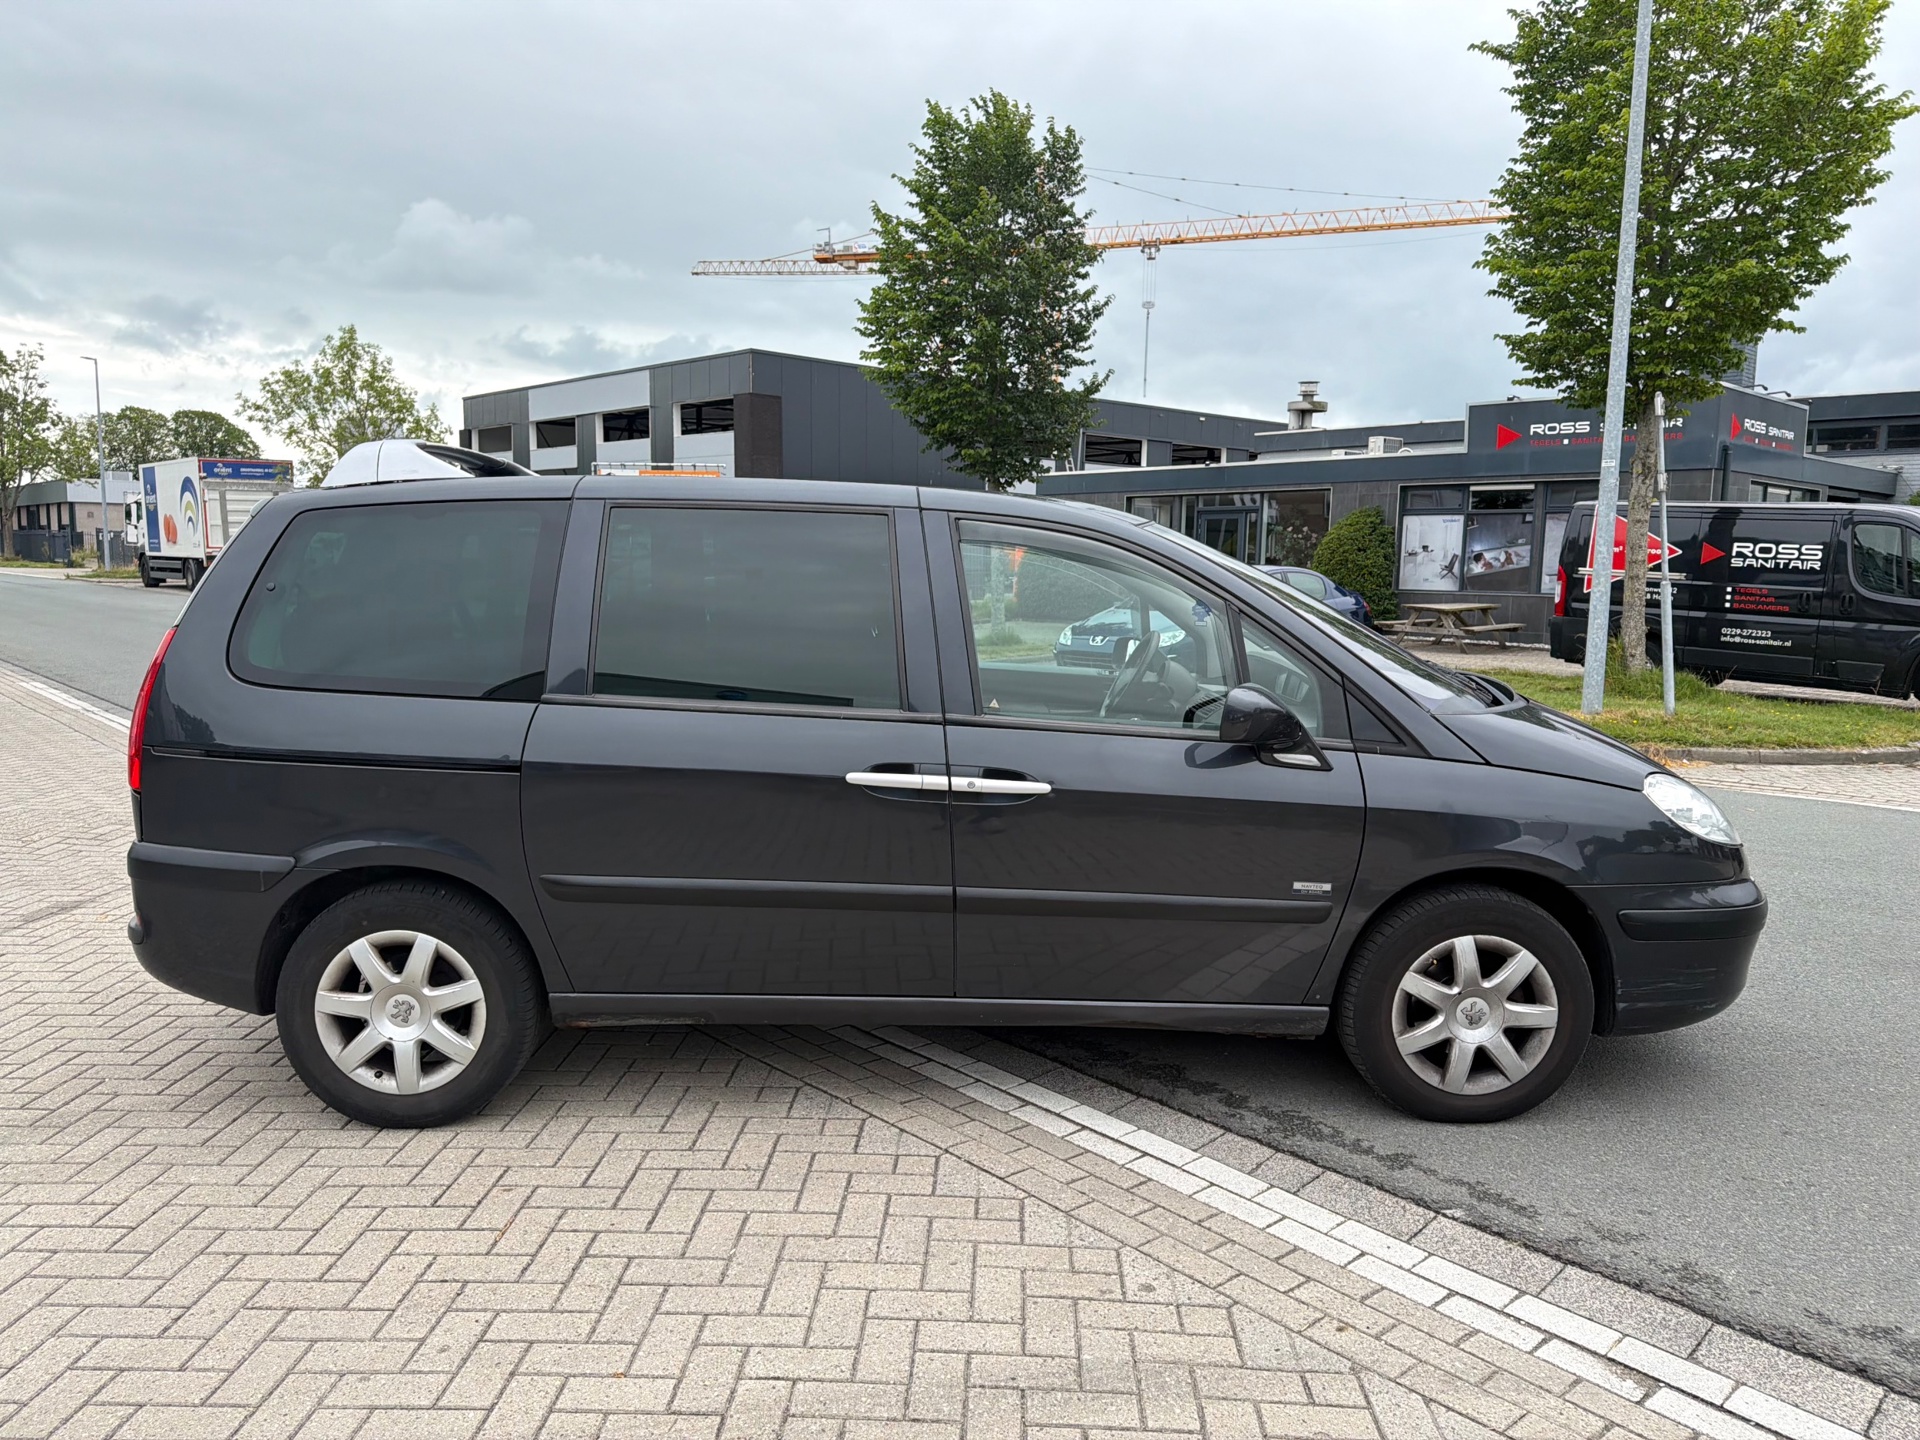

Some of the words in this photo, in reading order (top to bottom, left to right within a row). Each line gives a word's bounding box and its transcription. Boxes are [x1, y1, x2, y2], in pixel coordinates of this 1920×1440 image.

[1529, 421, 1591, 436] ROSS
[1744, 418, 1767, 434] ROSS
[1768, 426, 1795, 440] SANITAIR
[1530, 439, 1561, 447] TEGELS
[1571, 437, 1604, 445] SANITA
[1731, 542, 1824, 560] ROSS
[1730, 557, 1821, 571] SANITAIR
[1733, 603, 1790, 611] BADKAMERS
[1721, 627, 1772, 637] 0229-272323
[1720, 635, 1792, 647] info@ross-sanitair.nl
